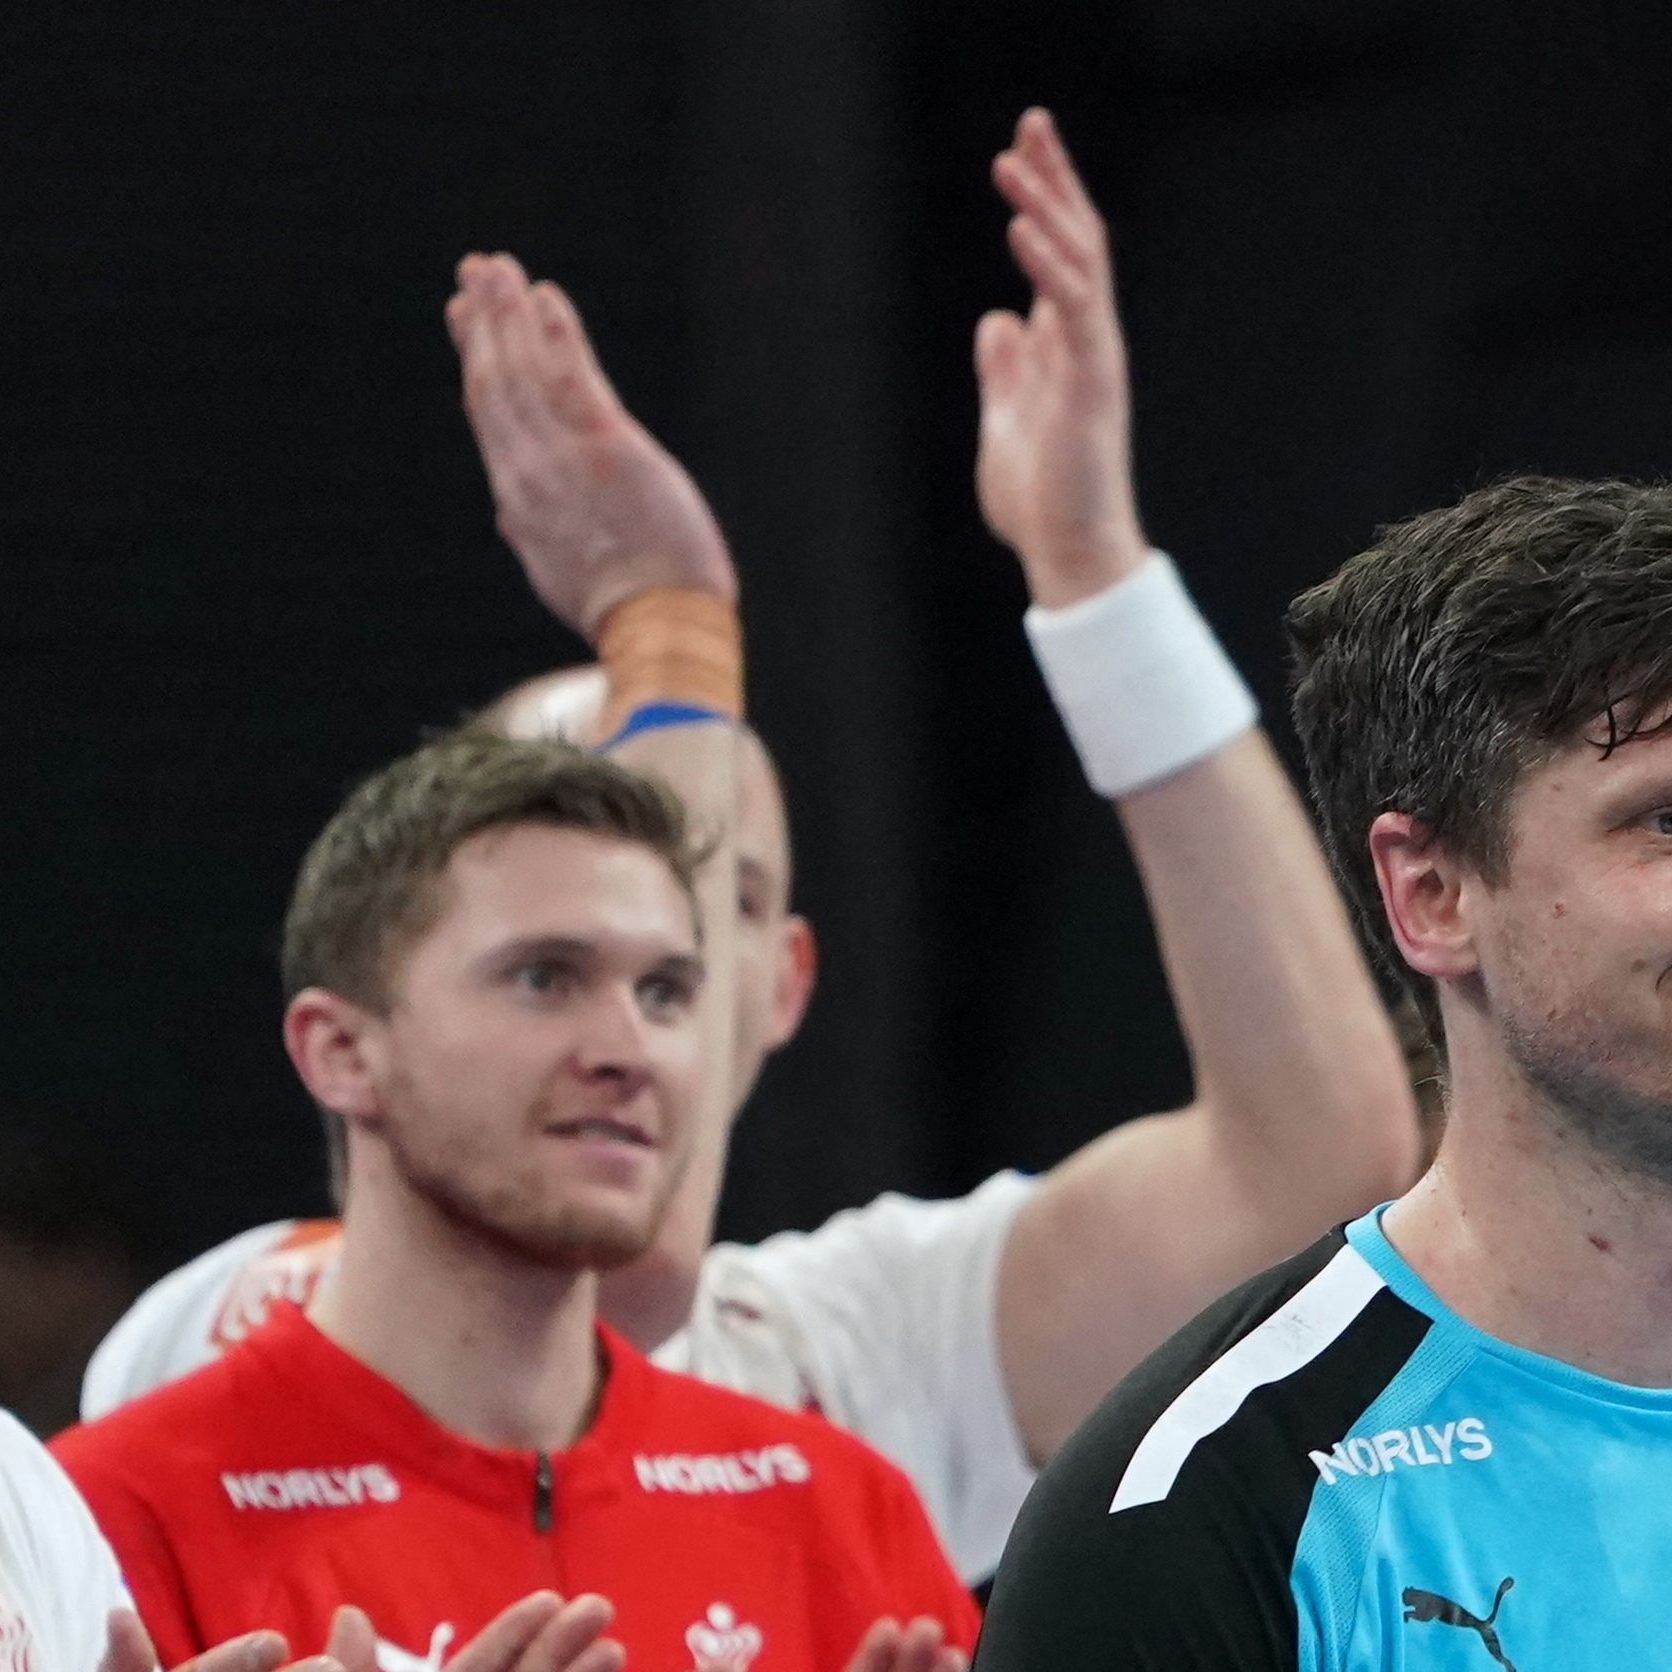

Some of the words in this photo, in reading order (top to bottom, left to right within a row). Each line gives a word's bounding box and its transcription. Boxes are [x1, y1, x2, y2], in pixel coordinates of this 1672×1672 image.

[633, 1443, 811, 1495] NORLYS
[1308, 1417, 1493, 1485] NORLYS
[221, 1463, 400, 1511] NORLYS
